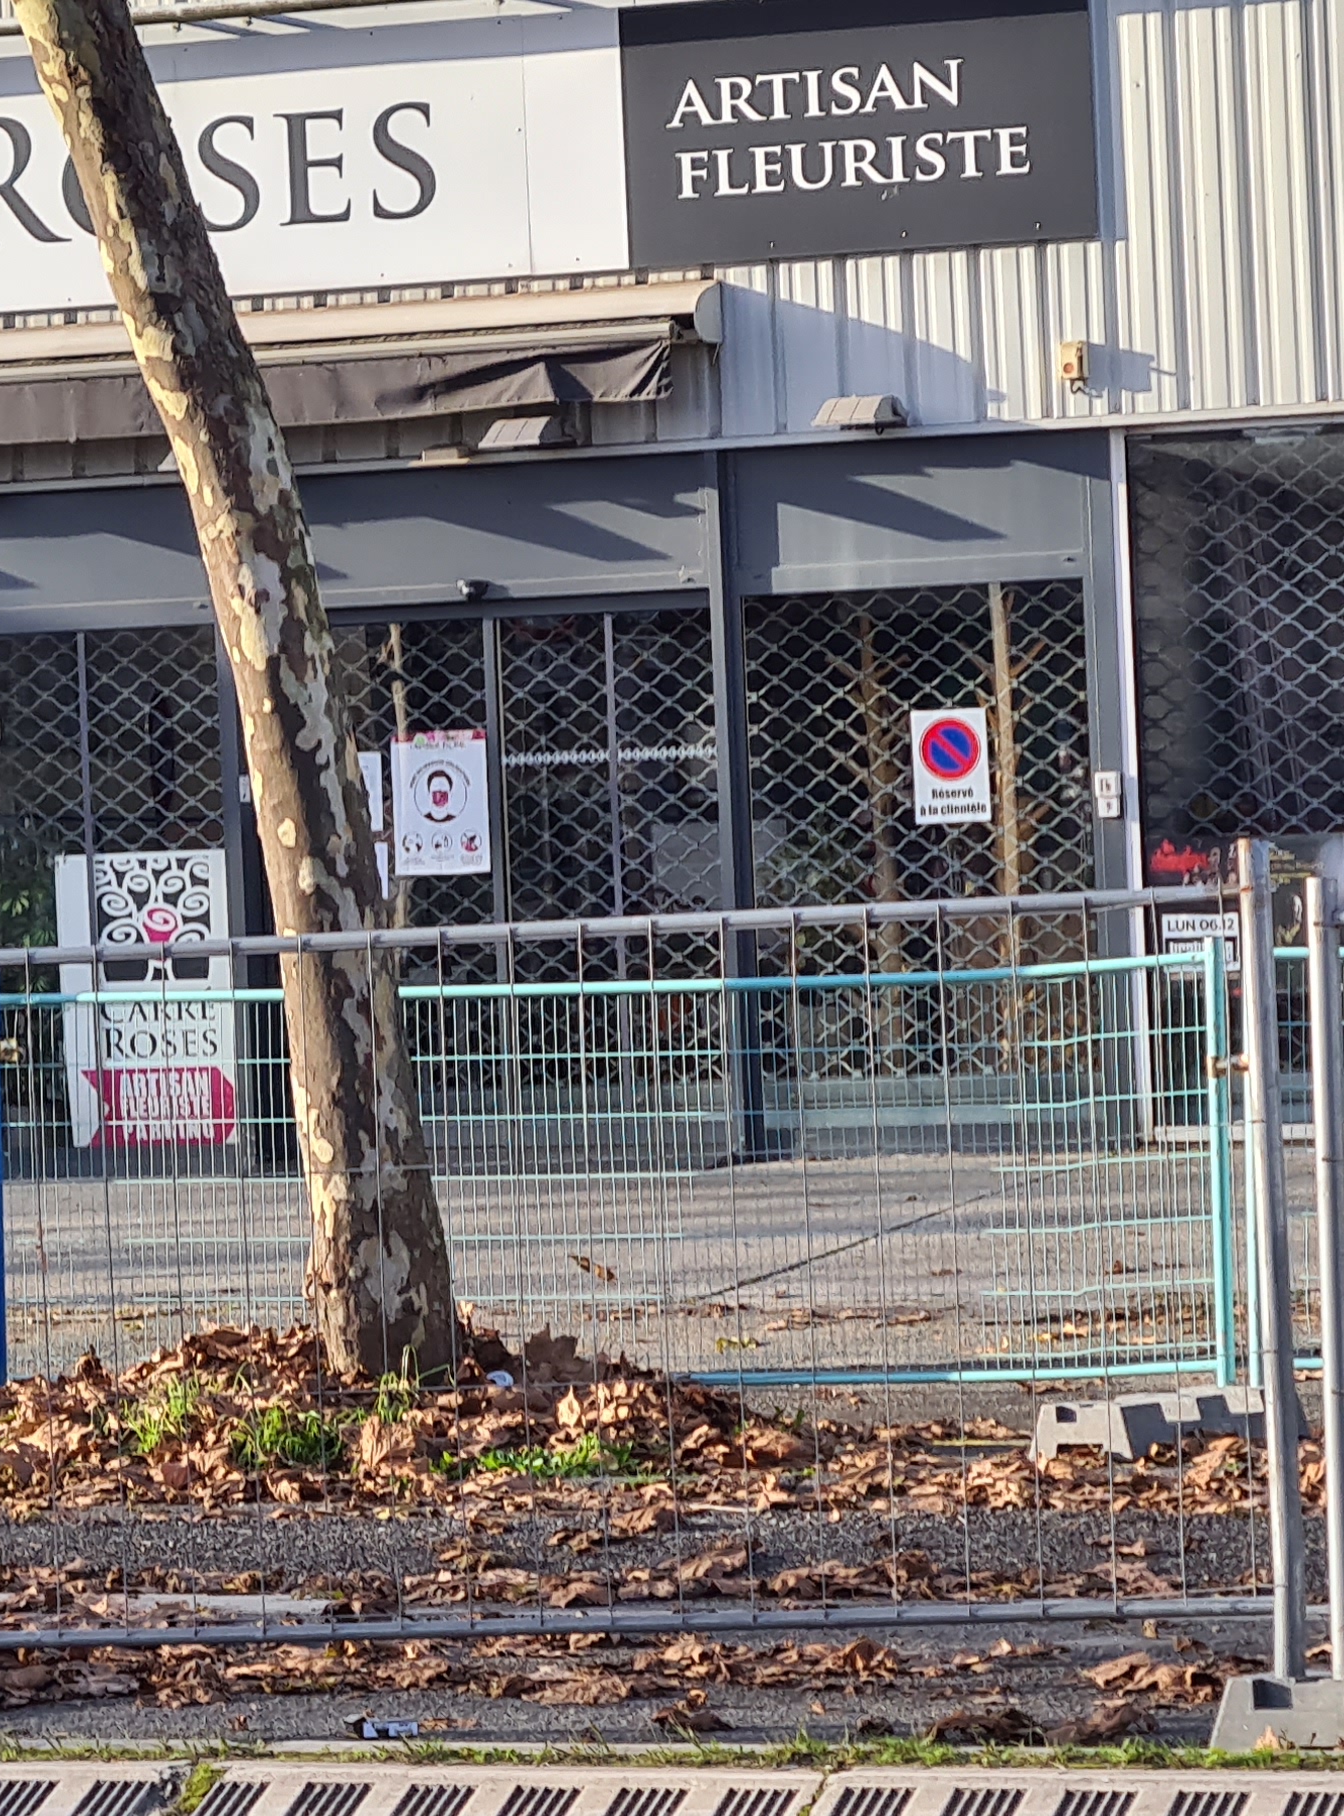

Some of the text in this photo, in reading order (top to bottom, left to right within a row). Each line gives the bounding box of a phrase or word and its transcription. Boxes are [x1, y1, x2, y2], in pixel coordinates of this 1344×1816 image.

[665, 57, 964, 130] ARTISAN
[675, 126, 1031, 201] FLEURISTE
[931, 785, 974, 800] Réservé
[929, 803, 939, 816] la
[941, 801, 987, 816] clientèle
[1167, 918, 1195, 932] LUN
[106, 1028, 219, 1060] ROSES
[120, 1070, 211, 1098] ARTISAN
